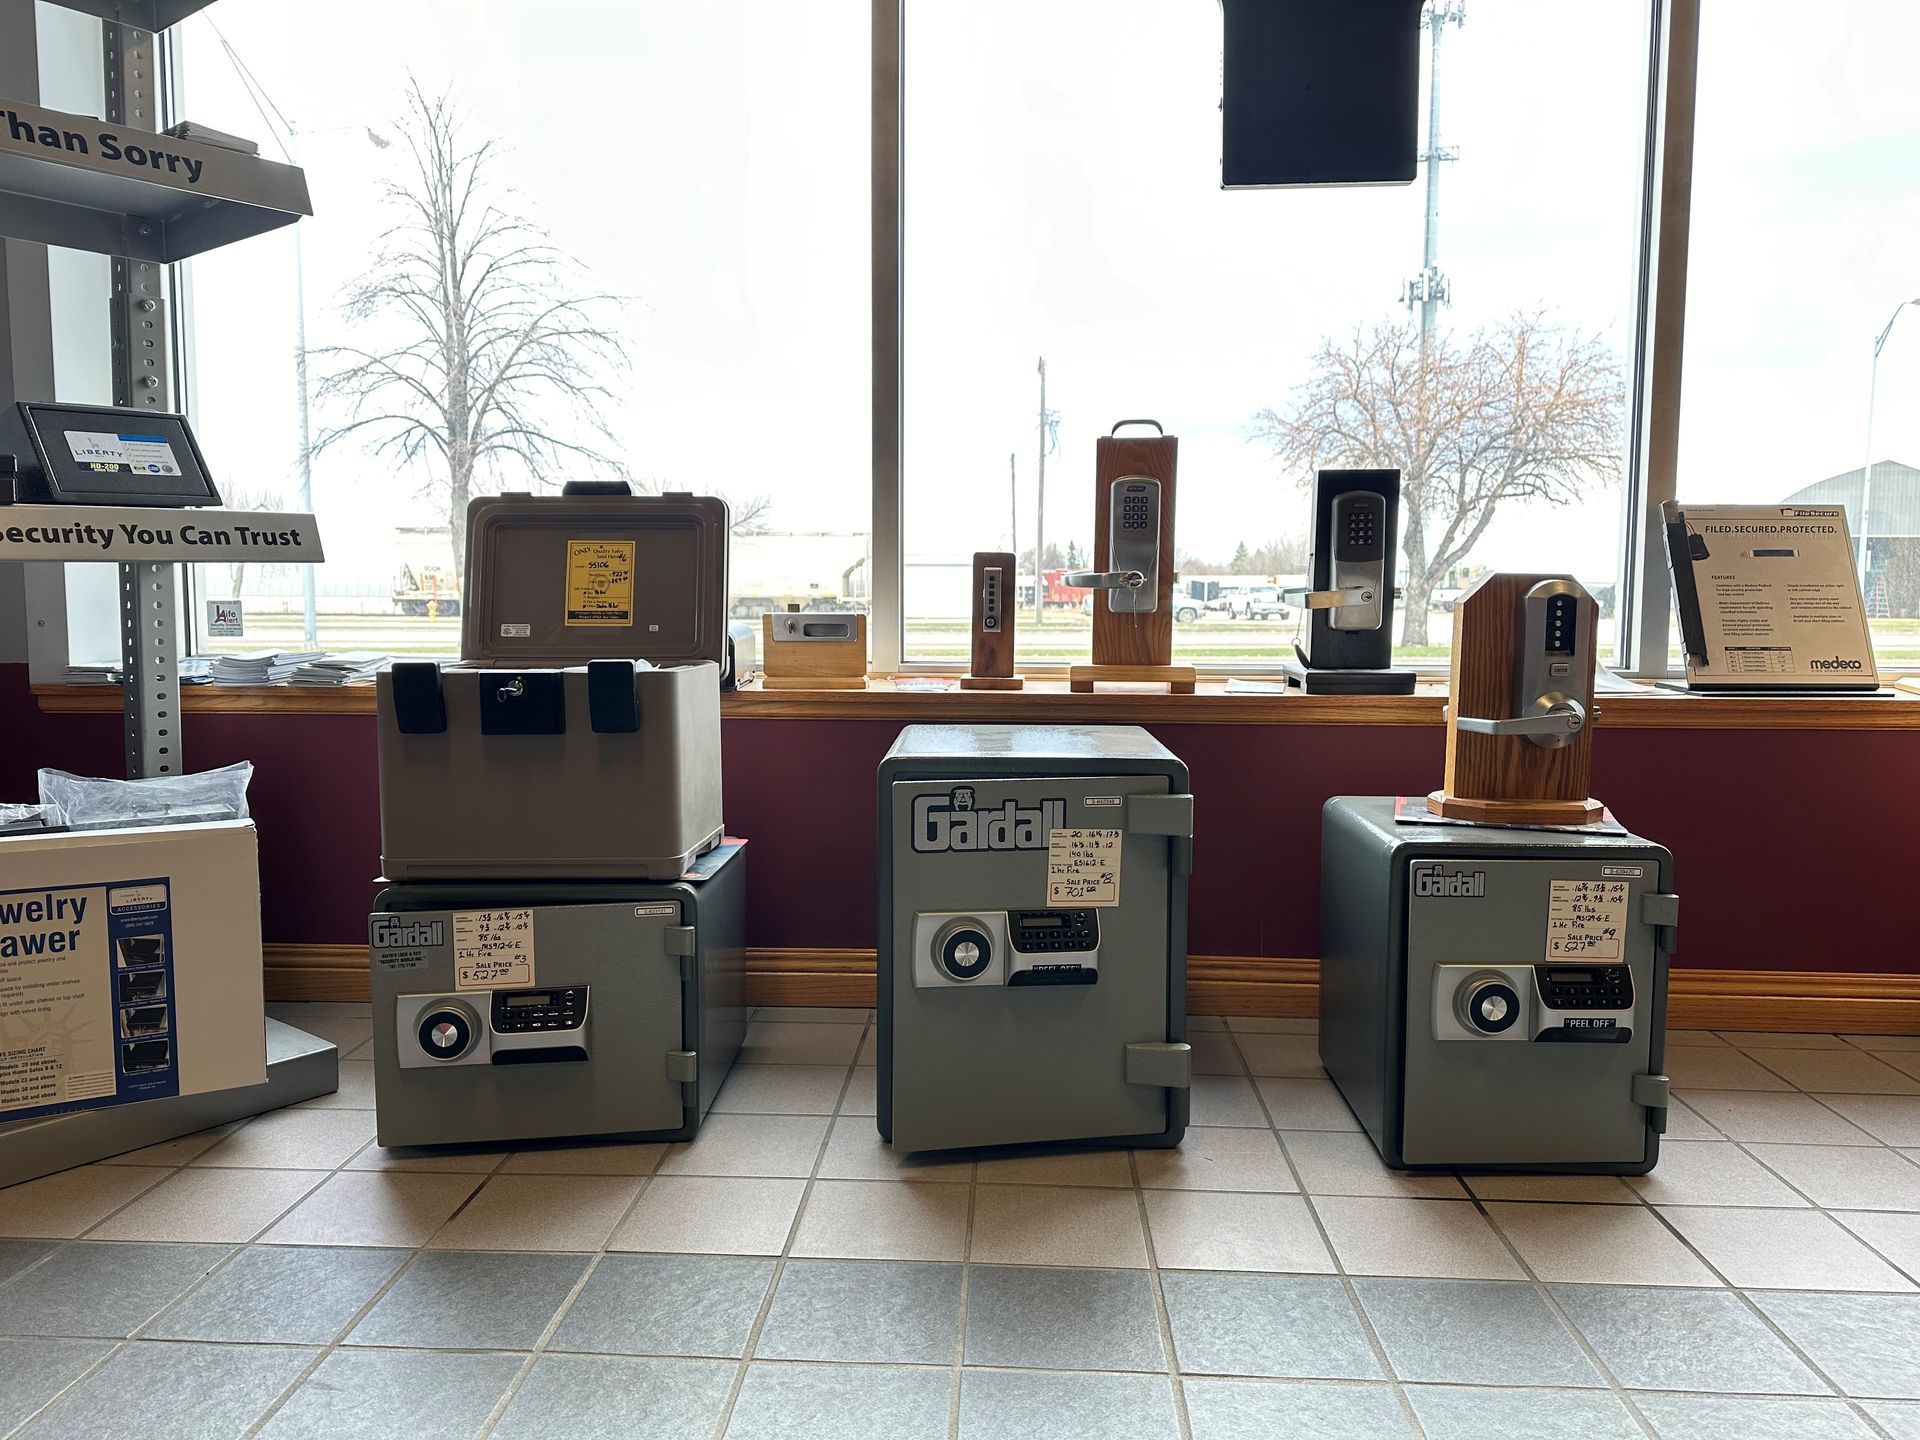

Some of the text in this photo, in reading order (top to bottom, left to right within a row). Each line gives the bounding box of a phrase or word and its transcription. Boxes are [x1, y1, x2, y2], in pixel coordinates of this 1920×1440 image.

[0, 110, 203, 184] han Sorry
[74, 449, 123, 458] LIBERTY
[90, 462, 119, 470] HD-200
[119, 524, 173, 545] You
[180, 525, 230, 546] Can
[235, 526, 302, 547] Trust
[1810, 656, 1862, 669] medeco
[911, 794, 1067, 853] Gardall
[1414, 868, 1487, 897] Gardall
[0, 894, 87, 925] welry
[118, 903, 161, 912] ACCESSORIES
[1584, 904, 1596, 913] lbs
[1572, 920, 1585, 928] Fire
[372, 920, 444, 949] Gardall
[0, 929, 80, 958] awer
[1553, 942, 1560, 950] $
[478, 950, 492, 958] Fire
[462, 971, 468, 979] $
